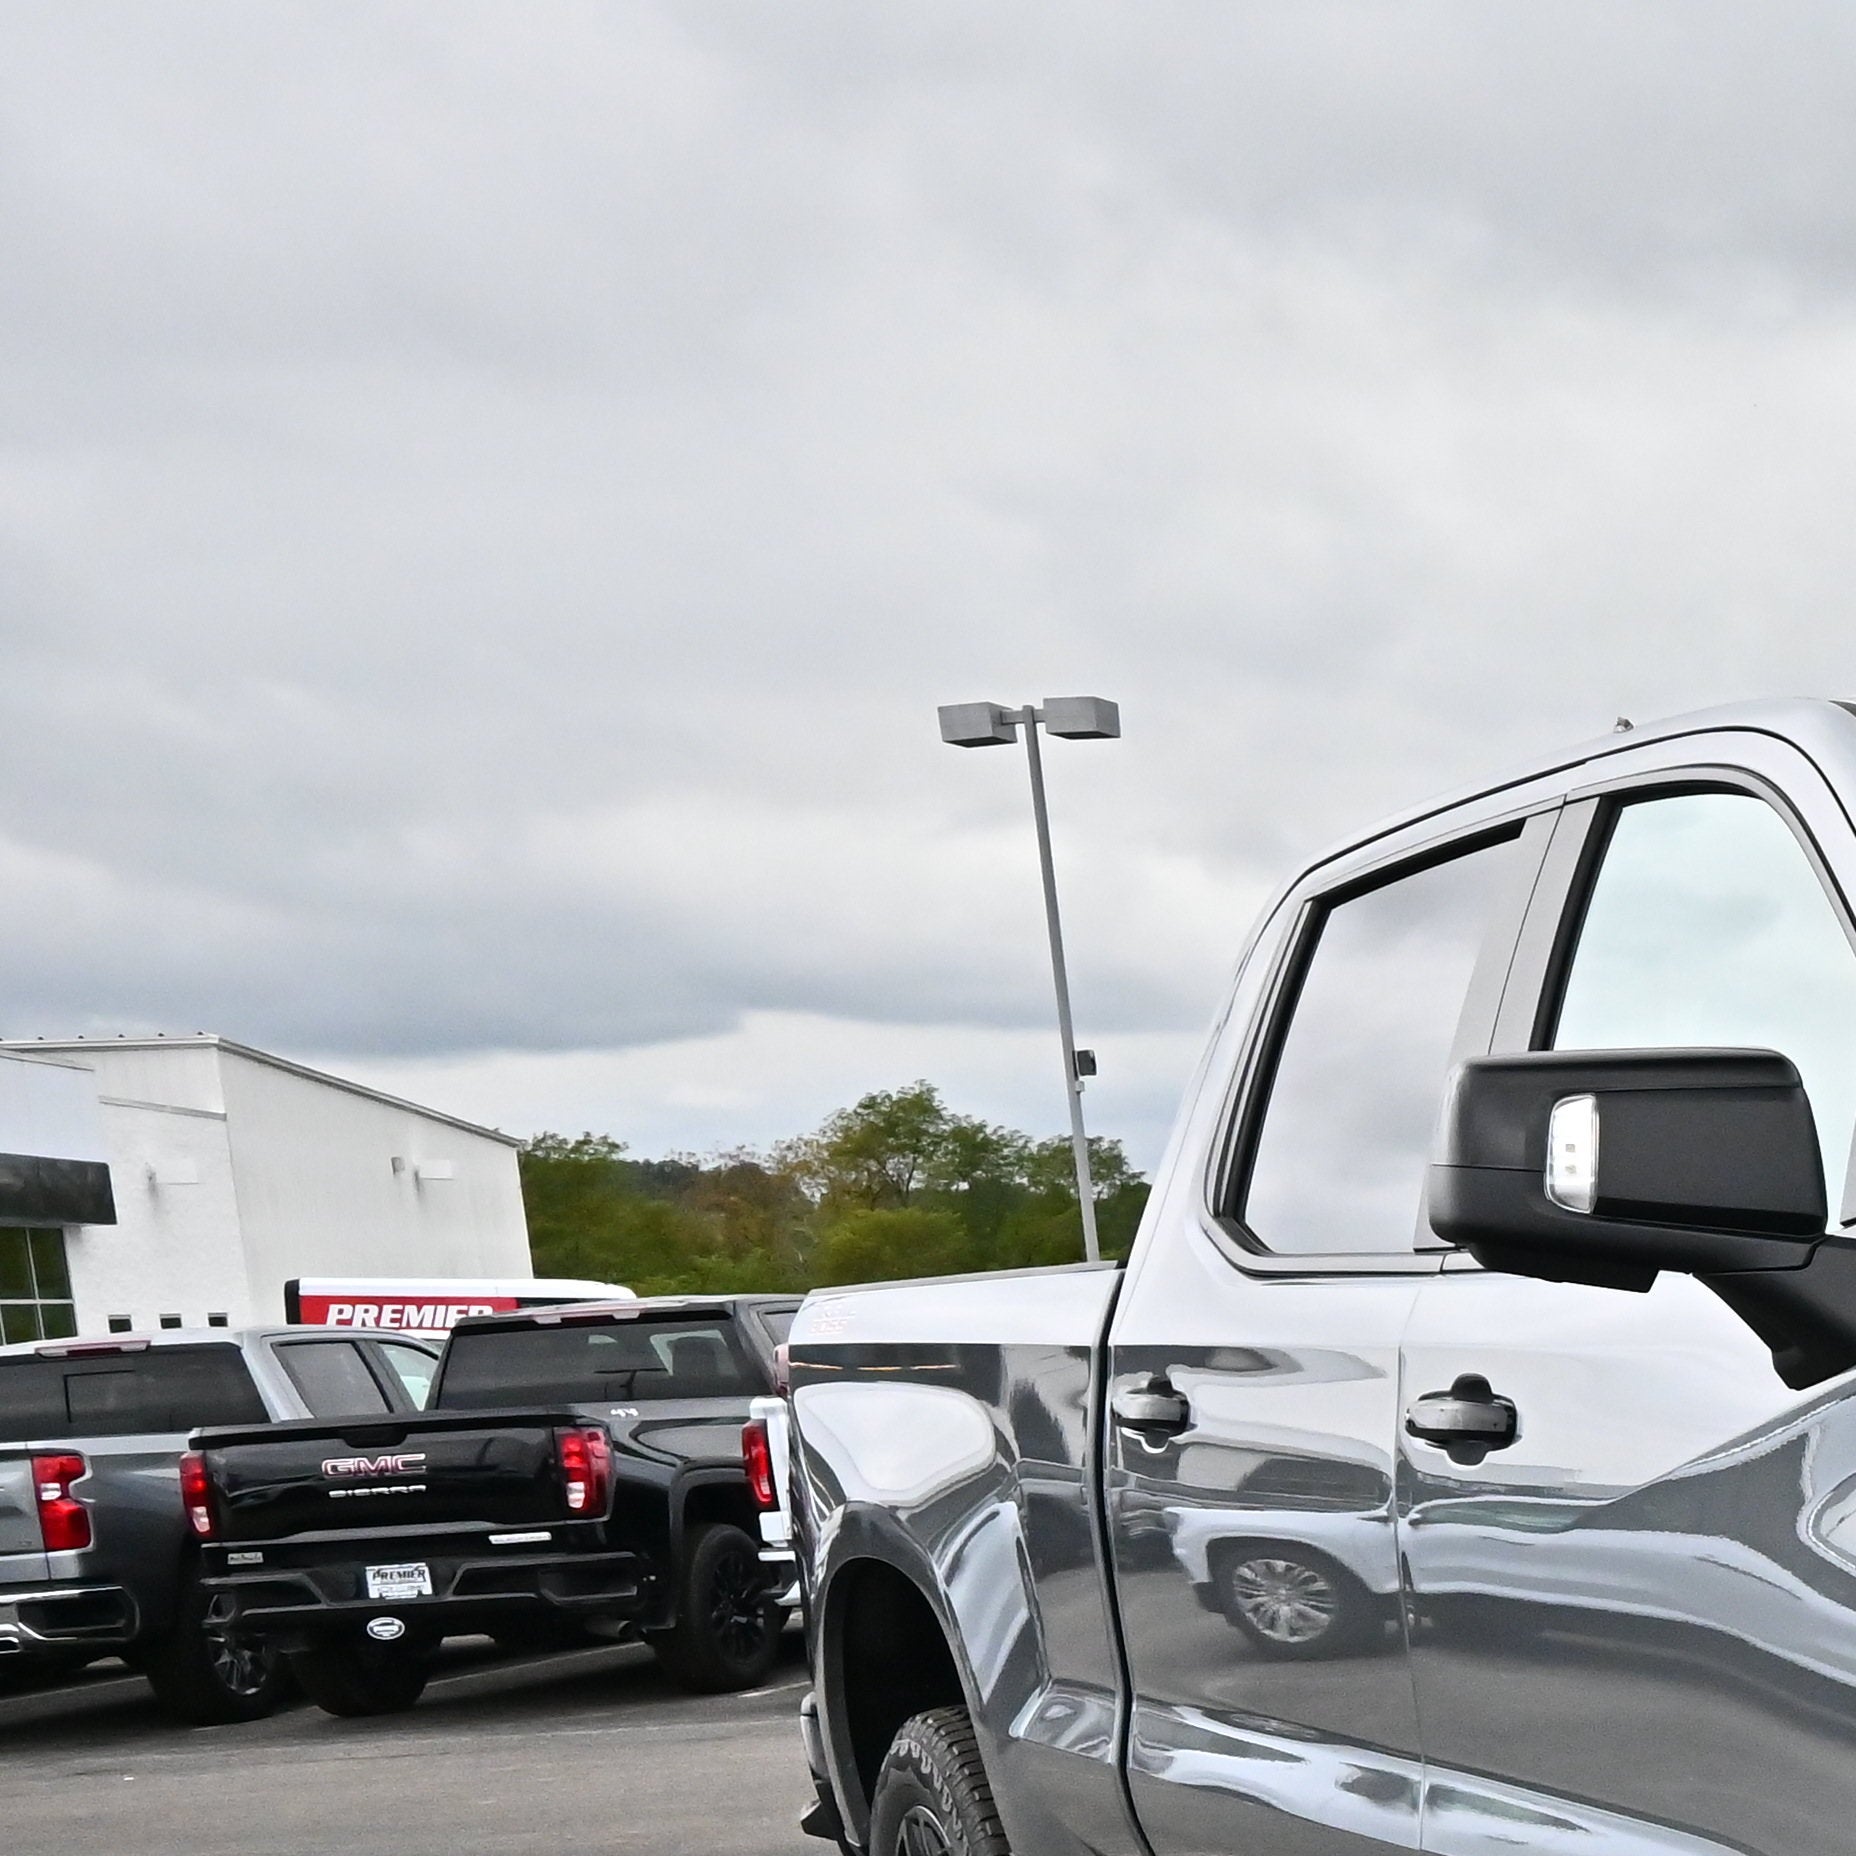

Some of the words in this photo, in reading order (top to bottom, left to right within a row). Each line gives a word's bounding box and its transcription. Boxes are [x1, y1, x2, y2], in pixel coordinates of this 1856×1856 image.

[321, 1453, 427, 1480] GMC
[328, 1484, 427, 1498] SIERRA
[372, 1568, 427, 1582] PREMIER
